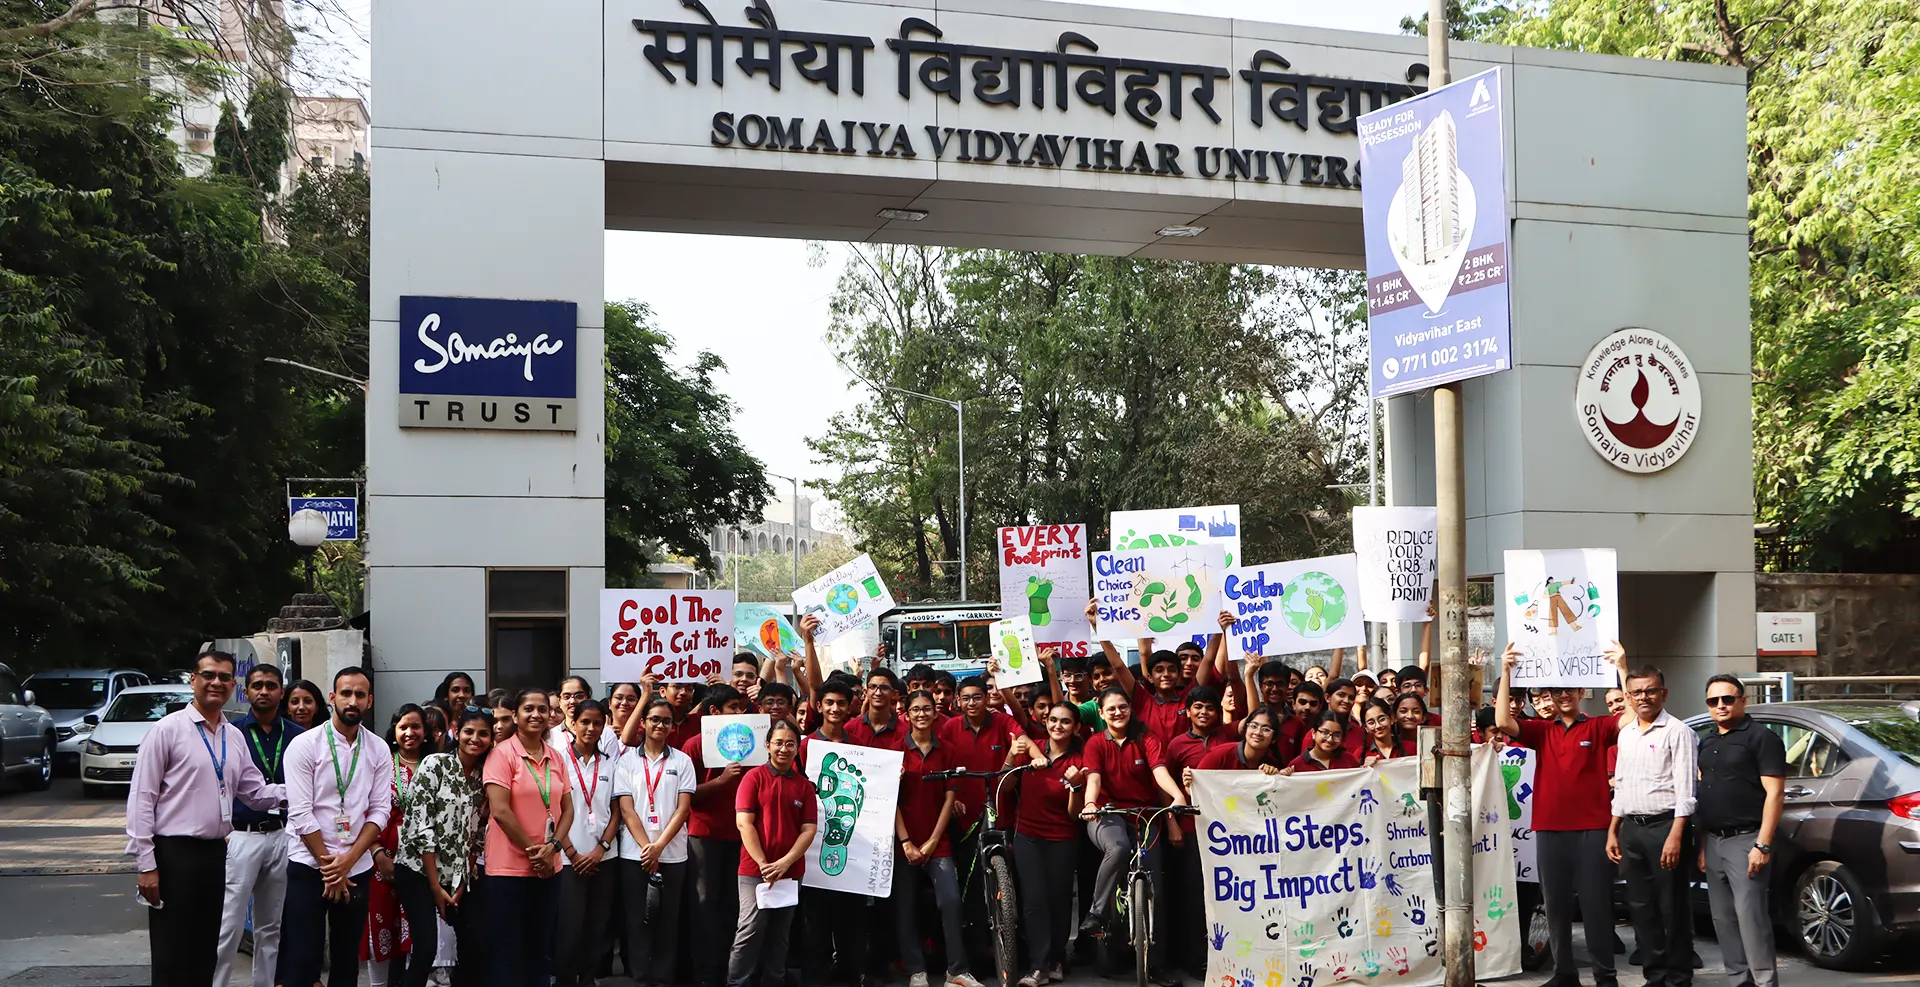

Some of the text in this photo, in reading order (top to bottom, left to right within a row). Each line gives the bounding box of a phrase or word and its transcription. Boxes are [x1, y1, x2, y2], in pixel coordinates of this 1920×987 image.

[632, 0, 874, 97] सोमैया
[888, 17, 1230, 128] विद्याविहार
[1362, 109, 1414, 136] READY FOR
[1363, 119, 1422, 147] POSSESSION
[711, 111, 917, 157] SOMAIYA
[926, 125, 1185, 177] VIDYAVIHAR
[1464, 252, 1494, 271] 2 BHK
[1375, 277, 1402, 293] 1 BHK
[1458, 268, 1486, 287] ₹2.25
[1370, 292, 1393, 309] ₹1.45
[1395, 316, 1482, 348] Vidyavihar East
[413, 312, 563, 382] Somaiya
[1402, 337, 1498, 374] 771 002 3174
[1586, 334, 1689, 380] Knowledge Alone Liberates
[414, 400, 562, 424] TRUST
[1584, 404, 1696, 467] Somaiya Vidyavihar
[319, 510, 353, 527] NATH
[1001, 525, 1080, 548] EVERY
[1387, 530, 1433, 545] REDUCE
[1004, 543, 1082, 568] Footprint
[1388, 545, 1423, 559] YOUR
[1096, 555, 1145, 577] Clean
[1097, 579, 1133, 591] Choices
[1225, 571, 1284, 601] Carbon
[1390, 573, 1424, 587] FOOT
[1104, 593, 1130, 603] clear
[1391, 587, 1429, 601] PRINT
[618, 594, 723, 630] Cool The
[1097, 606, 1141, 623] Skies
[611, 628, 729, 656] Earth Cut the
[1771, 633, 1803, 643] GATE 1
[646, 654, 721, 681] Carbon
[1515, 655, 1606, 678] ZERO WASTE
[1207, 818, 1280, 856] Small
[1386, 820, 1428, 841] Shrink
[879, 836, 893, 889] CARBON
[1389, 849, 1433, 869] Carbon
[1214, 867, 1255, 912] Big
